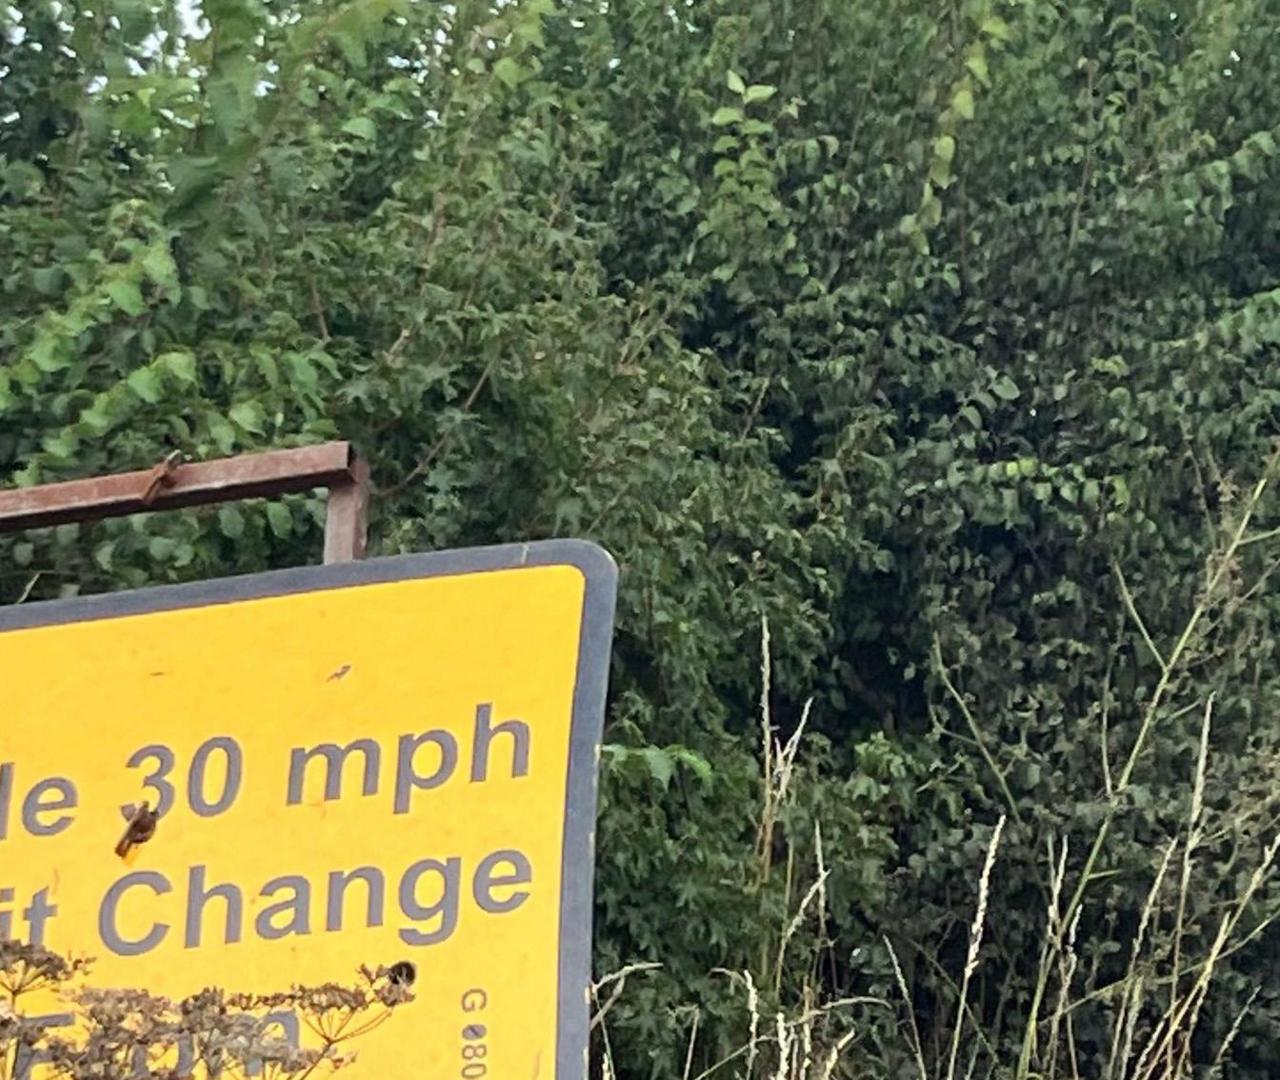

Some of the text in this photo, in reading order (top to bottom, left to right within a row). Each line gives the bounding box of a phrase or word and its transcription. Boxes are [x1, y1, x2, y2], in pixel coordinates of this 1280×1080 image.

[120, 736, 242, 823] 30
[286, 702, 531, 814] mph
[97, 848, 532, 957] Change
[461, 988, 487, 1013] G
